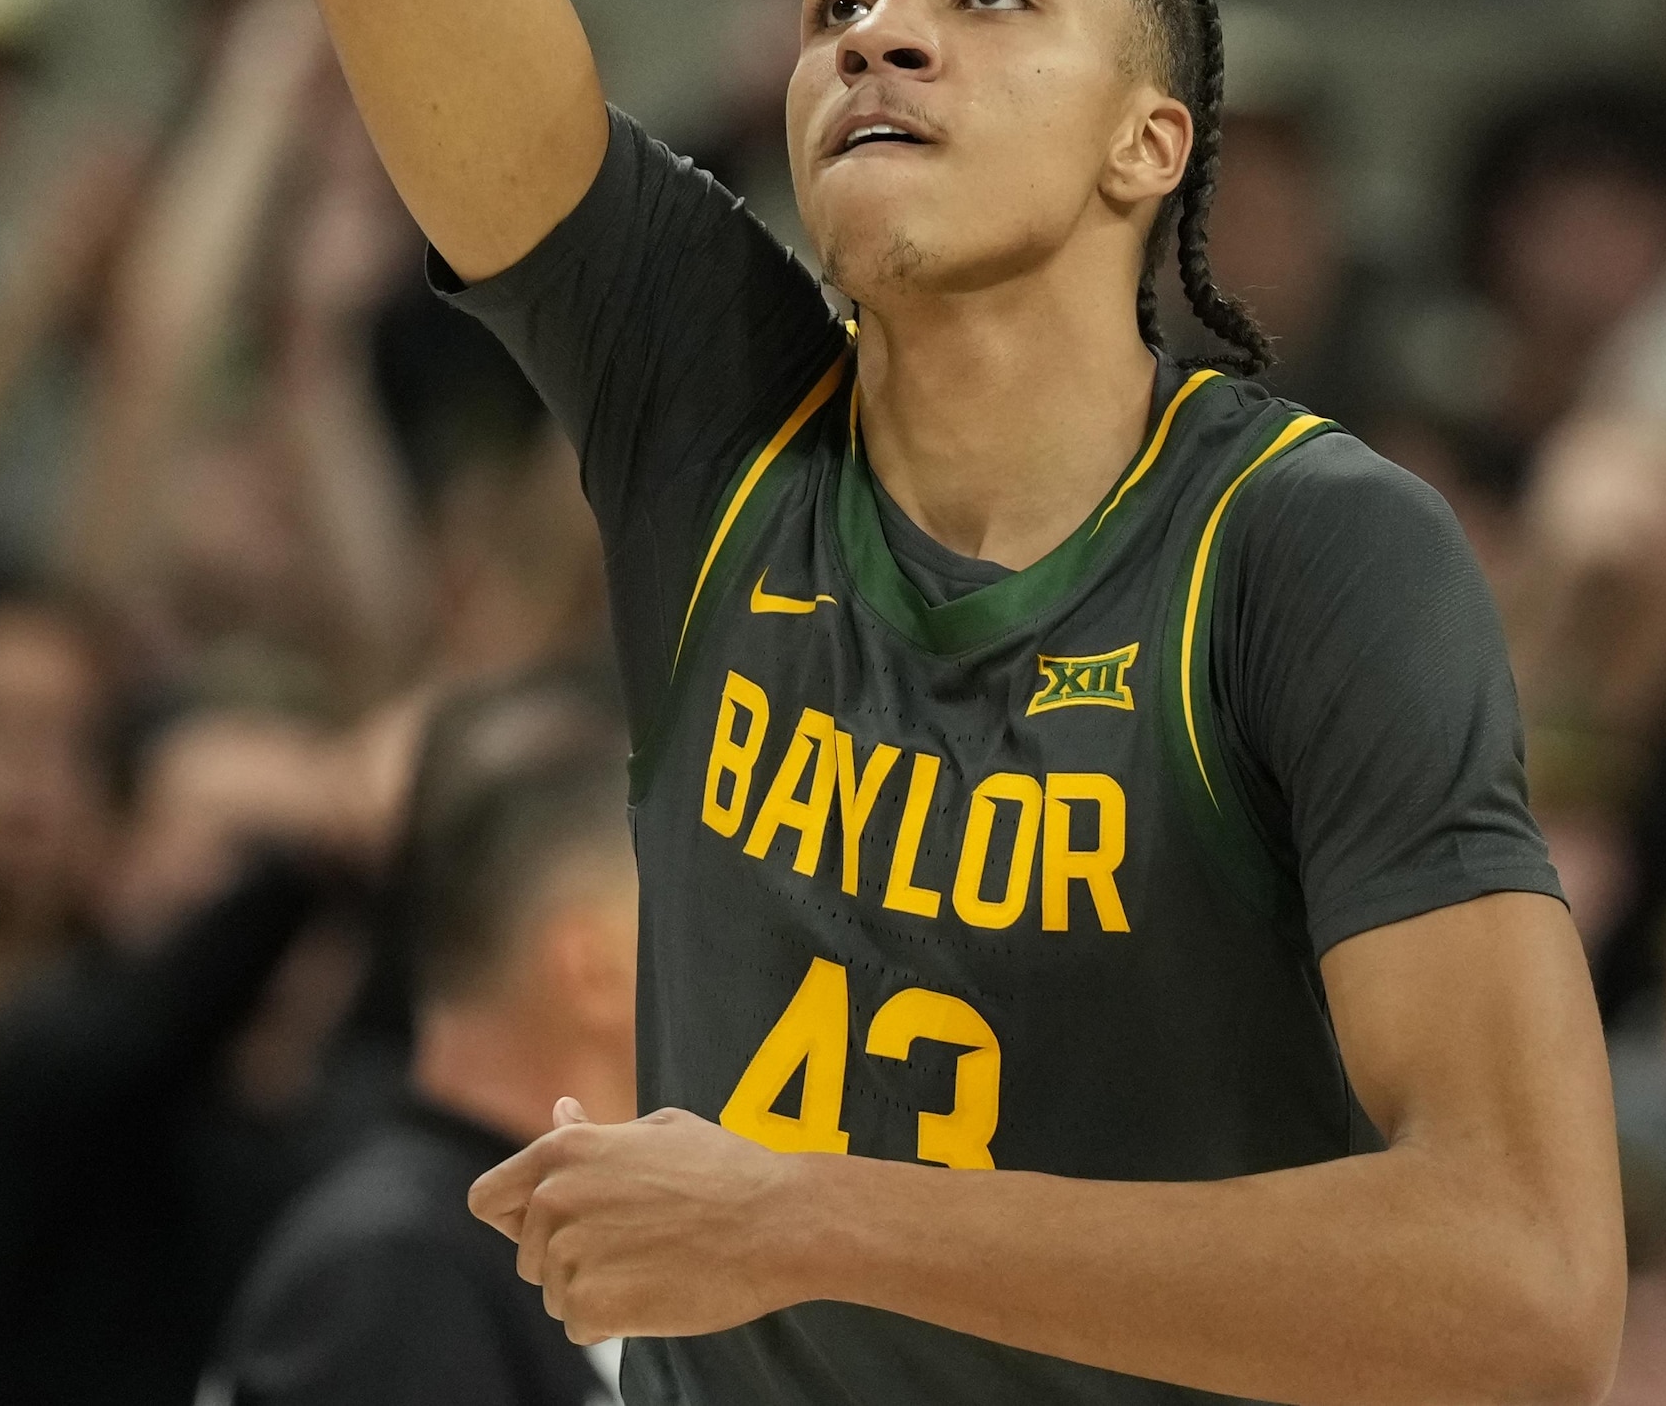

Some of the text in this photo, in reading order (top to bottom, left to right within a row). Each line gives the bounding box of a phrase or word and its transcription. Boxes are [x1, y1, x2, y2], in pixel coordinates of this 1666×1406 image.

[1035, 653, 1130, 707] XII
[701, 670, 1131, 933] BAYLOR
[719, 956, 1001, 1171] 43
